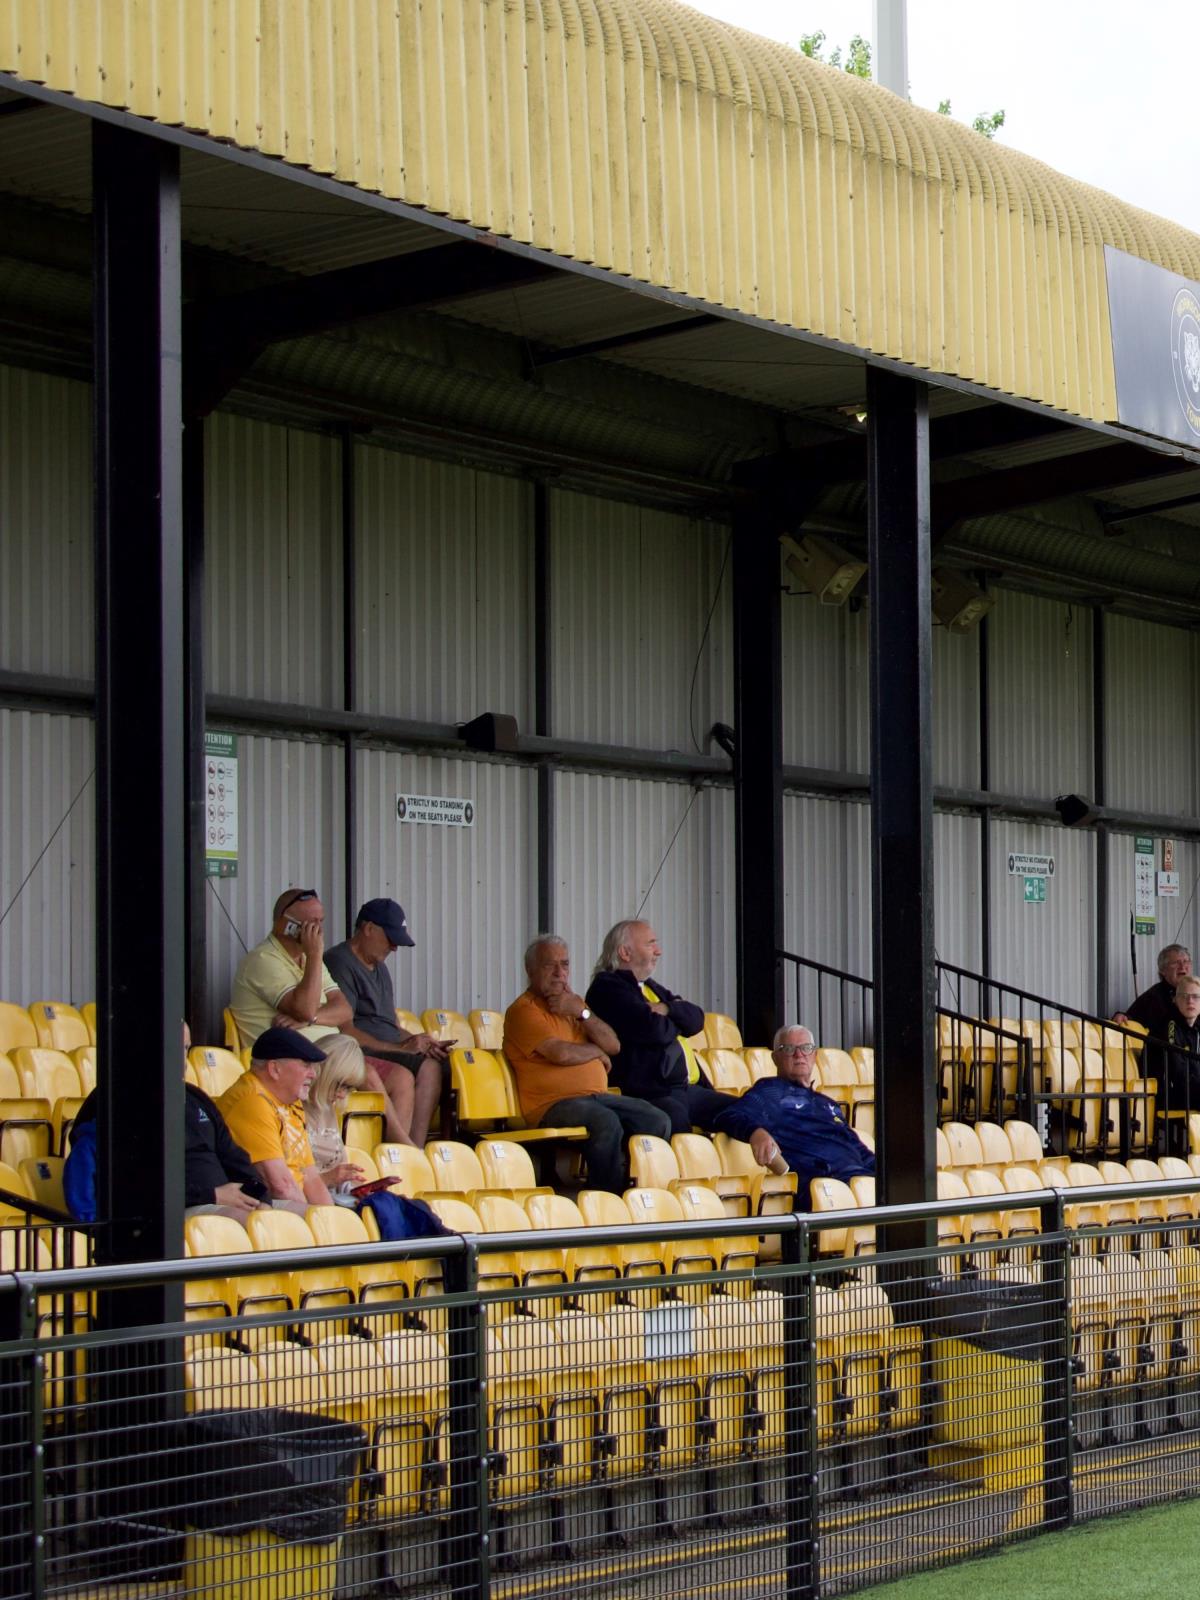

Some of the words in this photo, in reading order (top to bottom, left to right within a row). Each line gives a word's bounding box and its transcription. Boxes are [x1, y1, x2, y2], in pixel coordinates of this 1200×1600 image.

[205, 733, 233, 745] TTENTION
[408, 798, 430, 807] STRICTLY
[431, 800, 439, 808] NO
[440, 800, 464, 810] STANDING
[409, 811, 416, 819] ON
[418, 811, 427, 820] THE
[428, 812, 443, 821] SEATS
[444, 814, 462, 823] PLEASE
